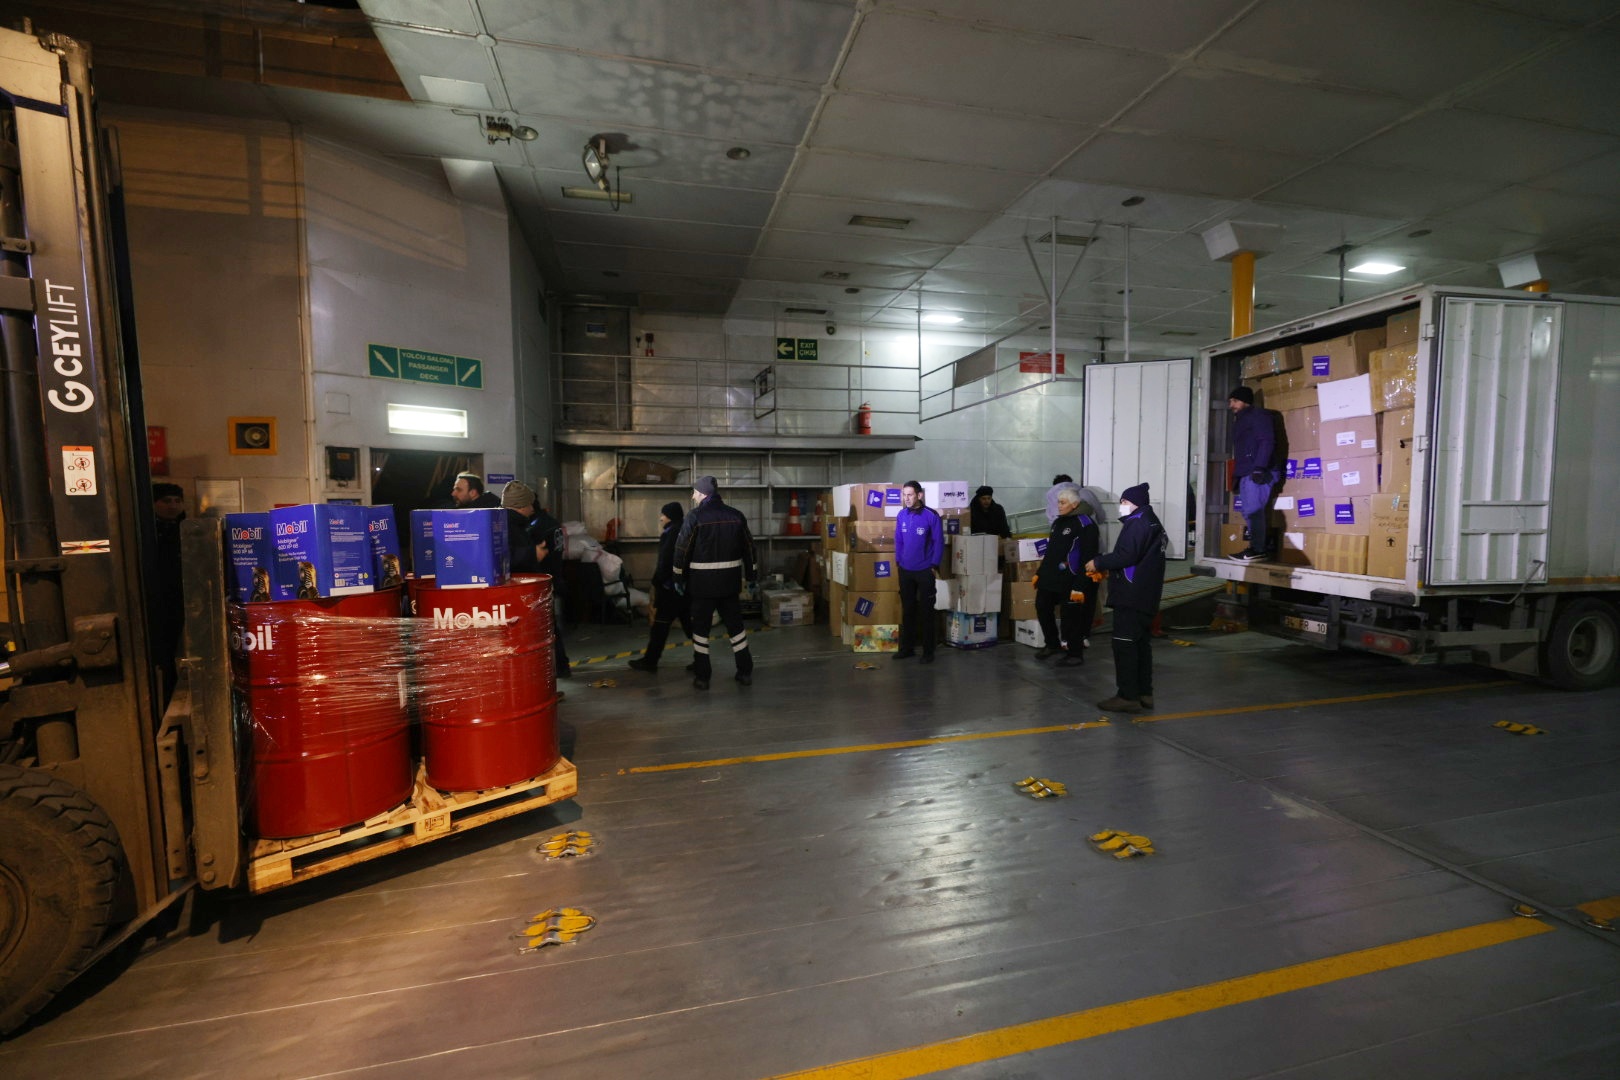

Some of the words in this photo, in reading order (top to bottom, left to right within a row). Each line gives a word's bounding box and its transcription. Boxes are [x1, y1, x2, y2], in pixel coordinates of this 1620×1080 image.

[44, 279, 84, 377] CEYLIFT
[402, 352, 426, 360] YOLCU
[427, 355, 454, 364] SALONU
[231, 528, 262, 540] Mobil
[276, 520, 308, 536] Mobil
[433, 604, 511, 629] Mobil
